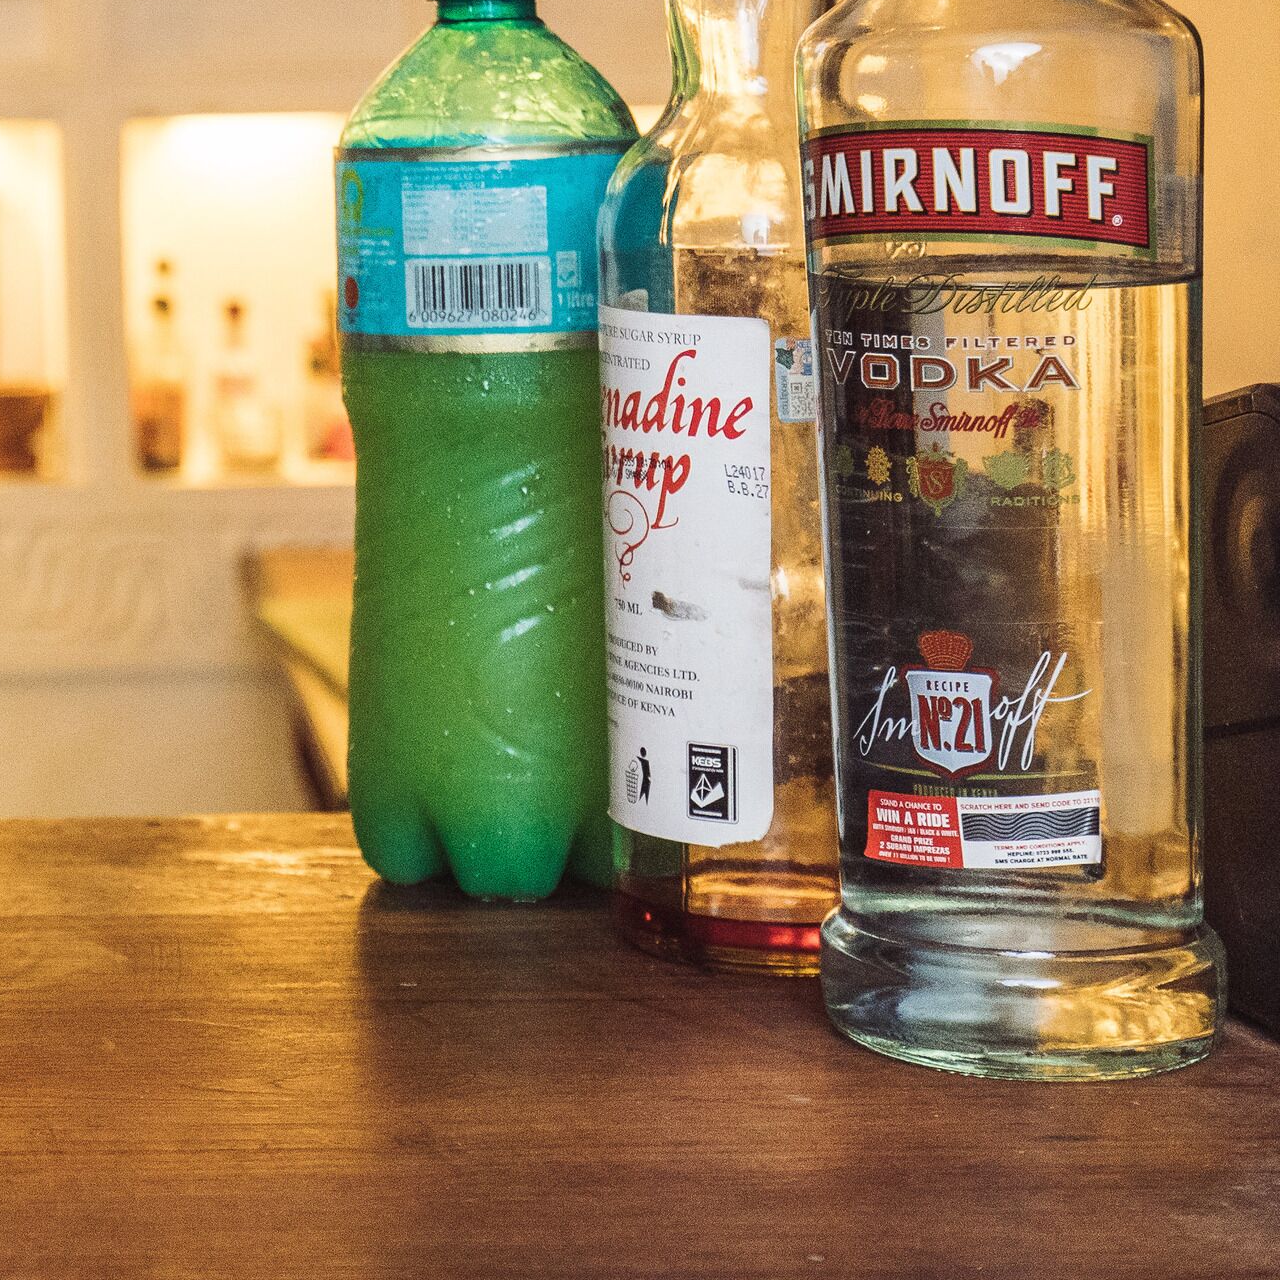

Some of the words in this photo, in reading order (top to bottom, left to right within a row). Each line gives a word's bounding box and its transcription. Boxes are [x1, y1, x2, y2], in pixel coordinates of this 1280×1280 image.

[818, 269, 899, 322] Tiple
[901, 272, 1100, 315] Distilled
[619, 327, 655, 343] SUGAR
[657, 331, 701, 346] SYRUP
[824, 329, 853, 346] TEN
[860, 333, 930, 350] TIMES
[945, 335, 1076, 350] FILTERED
[826, 348, 1082, 393] VODKA
[603, 349, 754, 440] nadine
[920, 402, 1019, 439] Smirnoff
[724, 463, 766, 481] L24017
[727, 480, 769, 499] B.B.27
[645, 645, 659, 656] BY
[624, 659, 670, 678] AGENCIES
[673, 669, 700, 682] LTD.
[646, 684, 693, 700] NAIROBI
[926, 680, 970, 693] RECIPE
[640, 701, 676, 717] KENYA
[691, 755, 722, 768] KEBS
[880, 798, 899, 808] STAND
[905, 801, 931, 810] CHANCE
[933, 803, 943, 811] TO
[1031, 801, 1050, 809] SEND
[1052, 799, 1070, 807] CODE
[876, 808, 900, 824] WIN
[904, 811, 913, 825] A
[917, 812, 950, 828] RIDE
[880, 841, 885, 849] 2
[886, 842, 912, 852] SUBARU
[913, 845, 951, 855] IMPREZAS
[890, 834, 912, 844] GRAND
[913, 837, 933, 846] PRIZE
[1029, 842, 1065, 850] CONDITIONS
